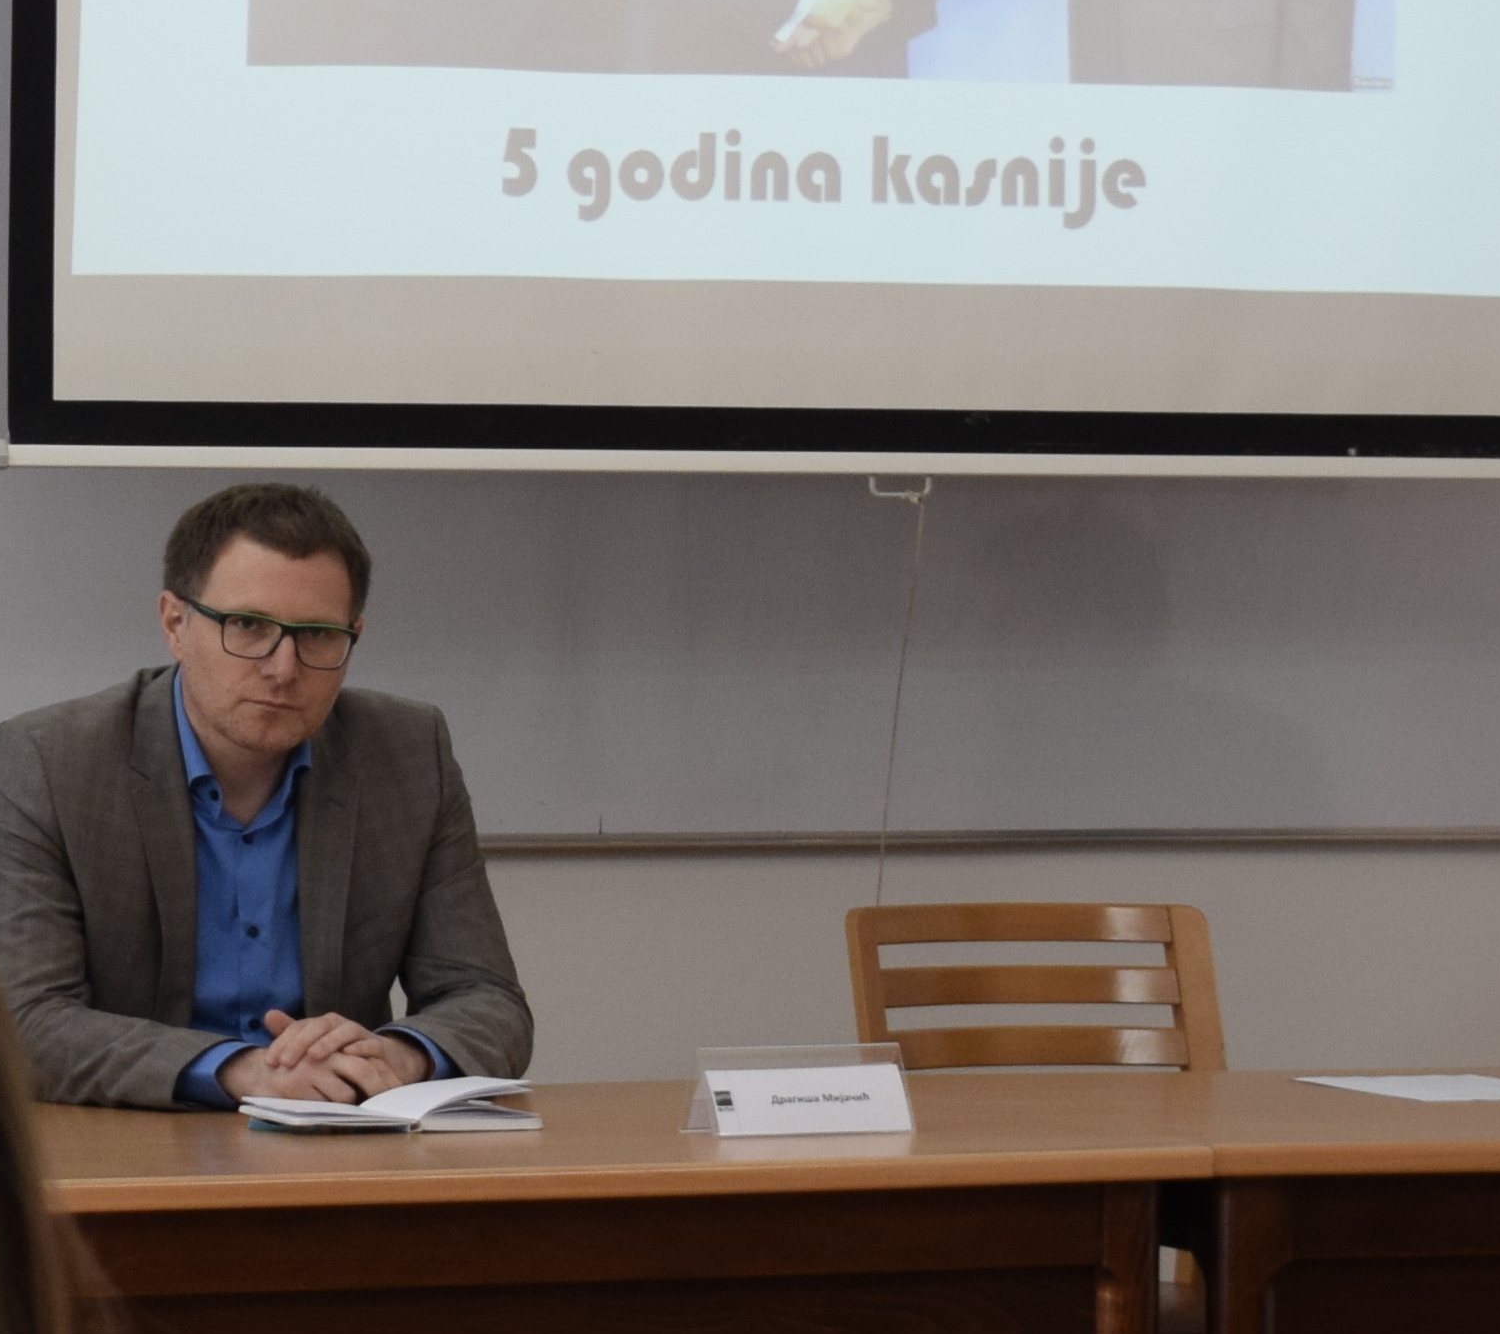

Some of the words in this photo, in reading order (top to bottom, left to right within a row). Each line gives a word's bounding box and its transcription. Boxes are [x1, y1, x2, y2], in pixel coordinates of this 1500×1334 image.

[501, 127, 538, 198] 5
[566, 128, 842, 223] godina
[871, 135, 1147, 231] kasnije
